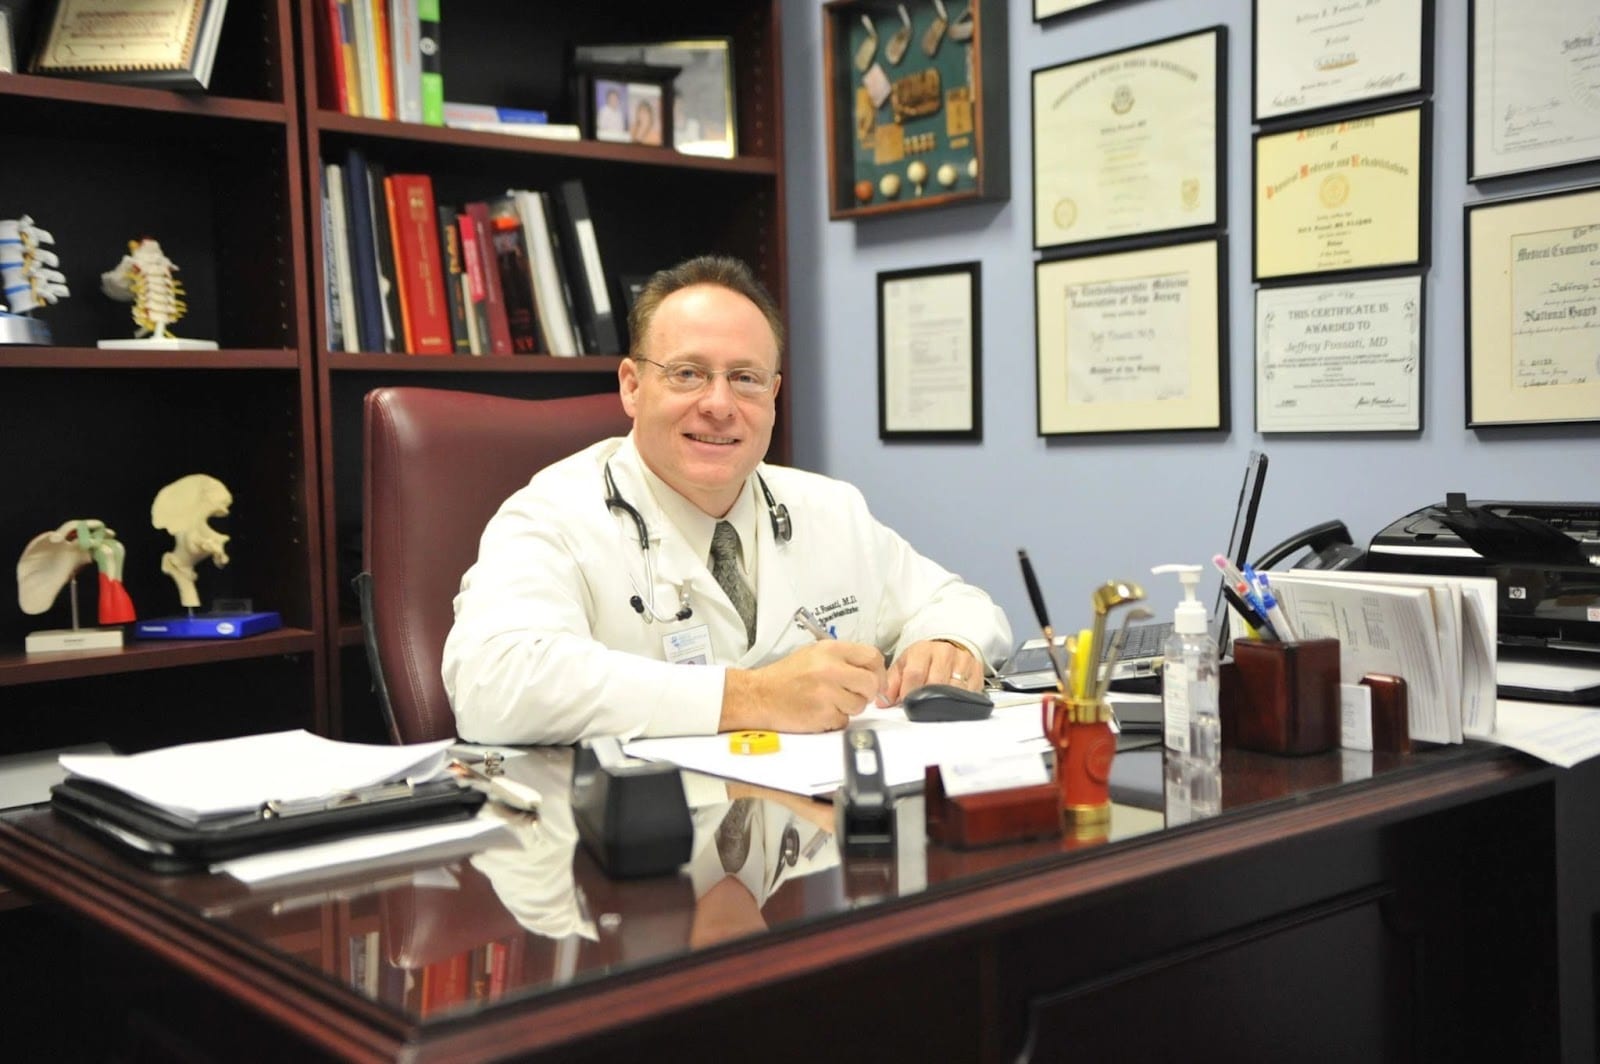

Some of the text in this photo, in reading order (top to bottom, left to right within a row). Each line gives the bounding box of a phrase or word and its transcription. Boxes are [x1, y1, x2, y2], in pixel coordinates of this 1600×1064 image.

[1551, 243, 1599, 258] Examiners
[1288, 302, 1389, 321] THIS CERTIFICATE IS
[1524, 306, 1597, 323] National Board
[1305, 320, 1371, 335] AWARDED TO
[1284, 340, 1321, 356] Jeffrey
[1369, 336, 1388, 348] MD
